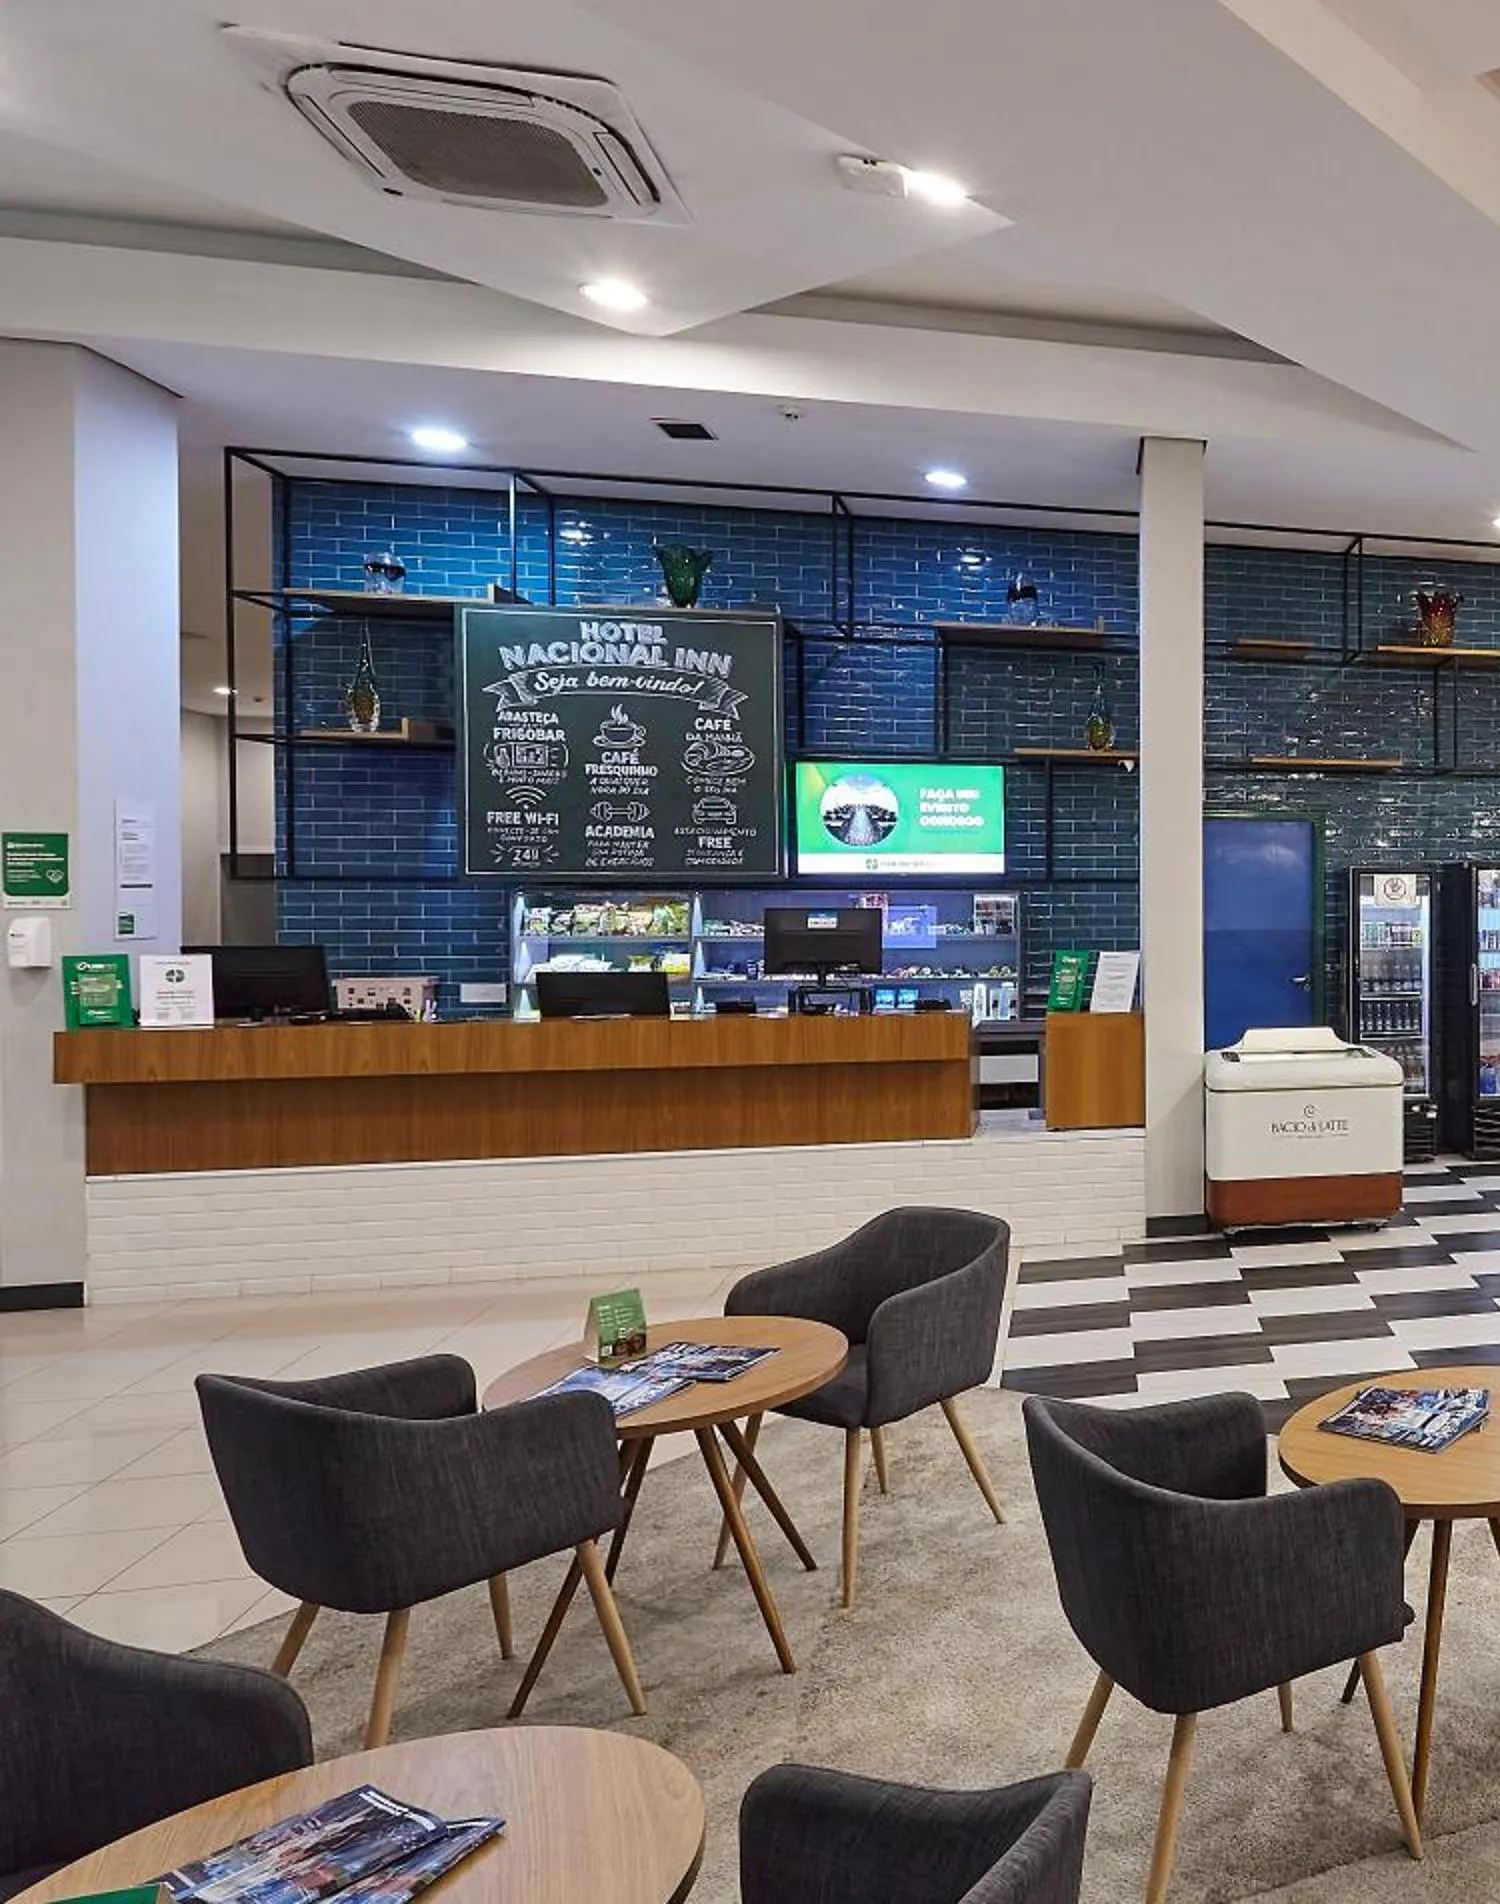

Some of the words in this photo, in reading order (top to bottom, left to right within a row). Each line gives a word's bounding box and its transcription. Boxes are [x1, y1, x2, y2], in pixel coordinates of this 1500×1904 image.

[579, 621, 667, 645] HOTEL
[499, 641, 668, 670] NACIONAL
[674, 647, 733, 678] INN
[534, 671, 578, 694] Seja
[586, 672, 704, 695] bem-vindo!
[493, 728, 566, 742] FRIGOBAR
[601, 748, 640, 764] CAFÉ
[585, 764, 659, 777] FRESQUINHO
[487, 811, 521, 825] FREE
[525, 812, 559, 826] WI-FI
[585, 826, 655, 839] ACADEMIA
[698, 836, 733, 849] FREE
